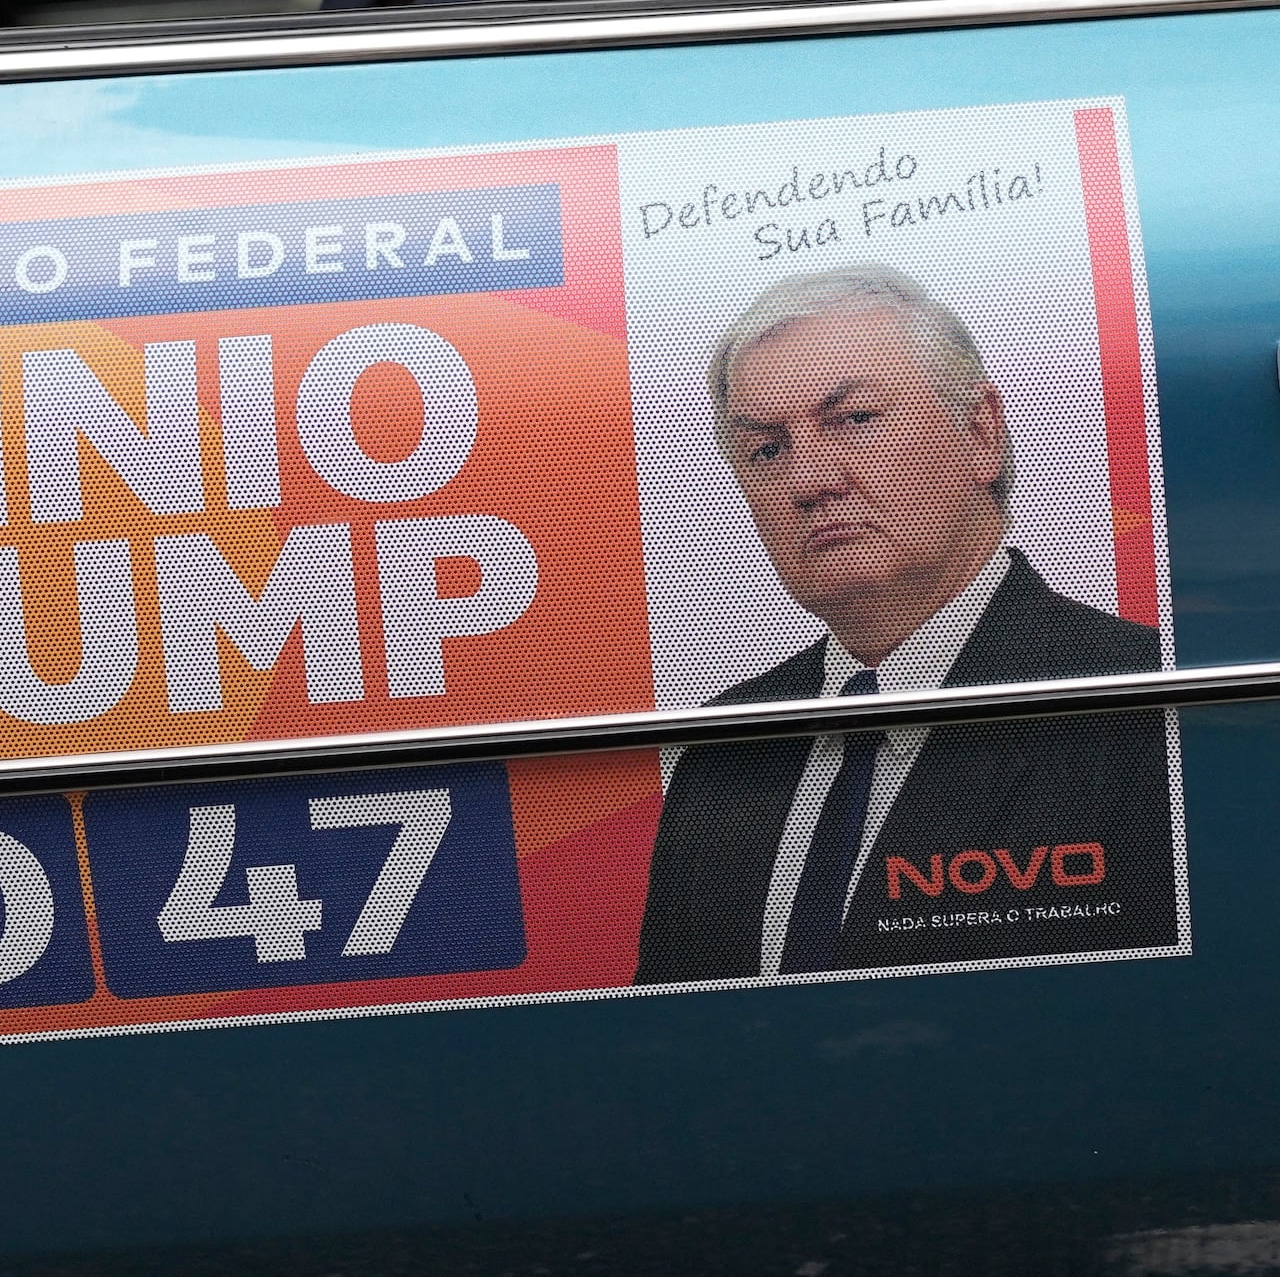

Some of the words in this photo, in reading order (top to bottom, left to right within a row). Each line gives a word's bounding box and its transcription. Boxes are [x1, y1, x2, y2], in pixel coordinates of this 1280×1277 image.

[639, 146, 918, 239] Defendendo
[753, 218, 842, 261] Sua
[861, 162, 1045, 236] Família!
[118, 212, 531, 290] FEDERAL
[155, 787, 453, 964] 47
[885, 842, 1106, 900] NOVO
[877, 916, 927, 933] NADA
[931, 910, 1002, 928] SUPERA
[1006, 909, 1020, 922] O
[1024, 901, 1122, 921] TRABALHO
